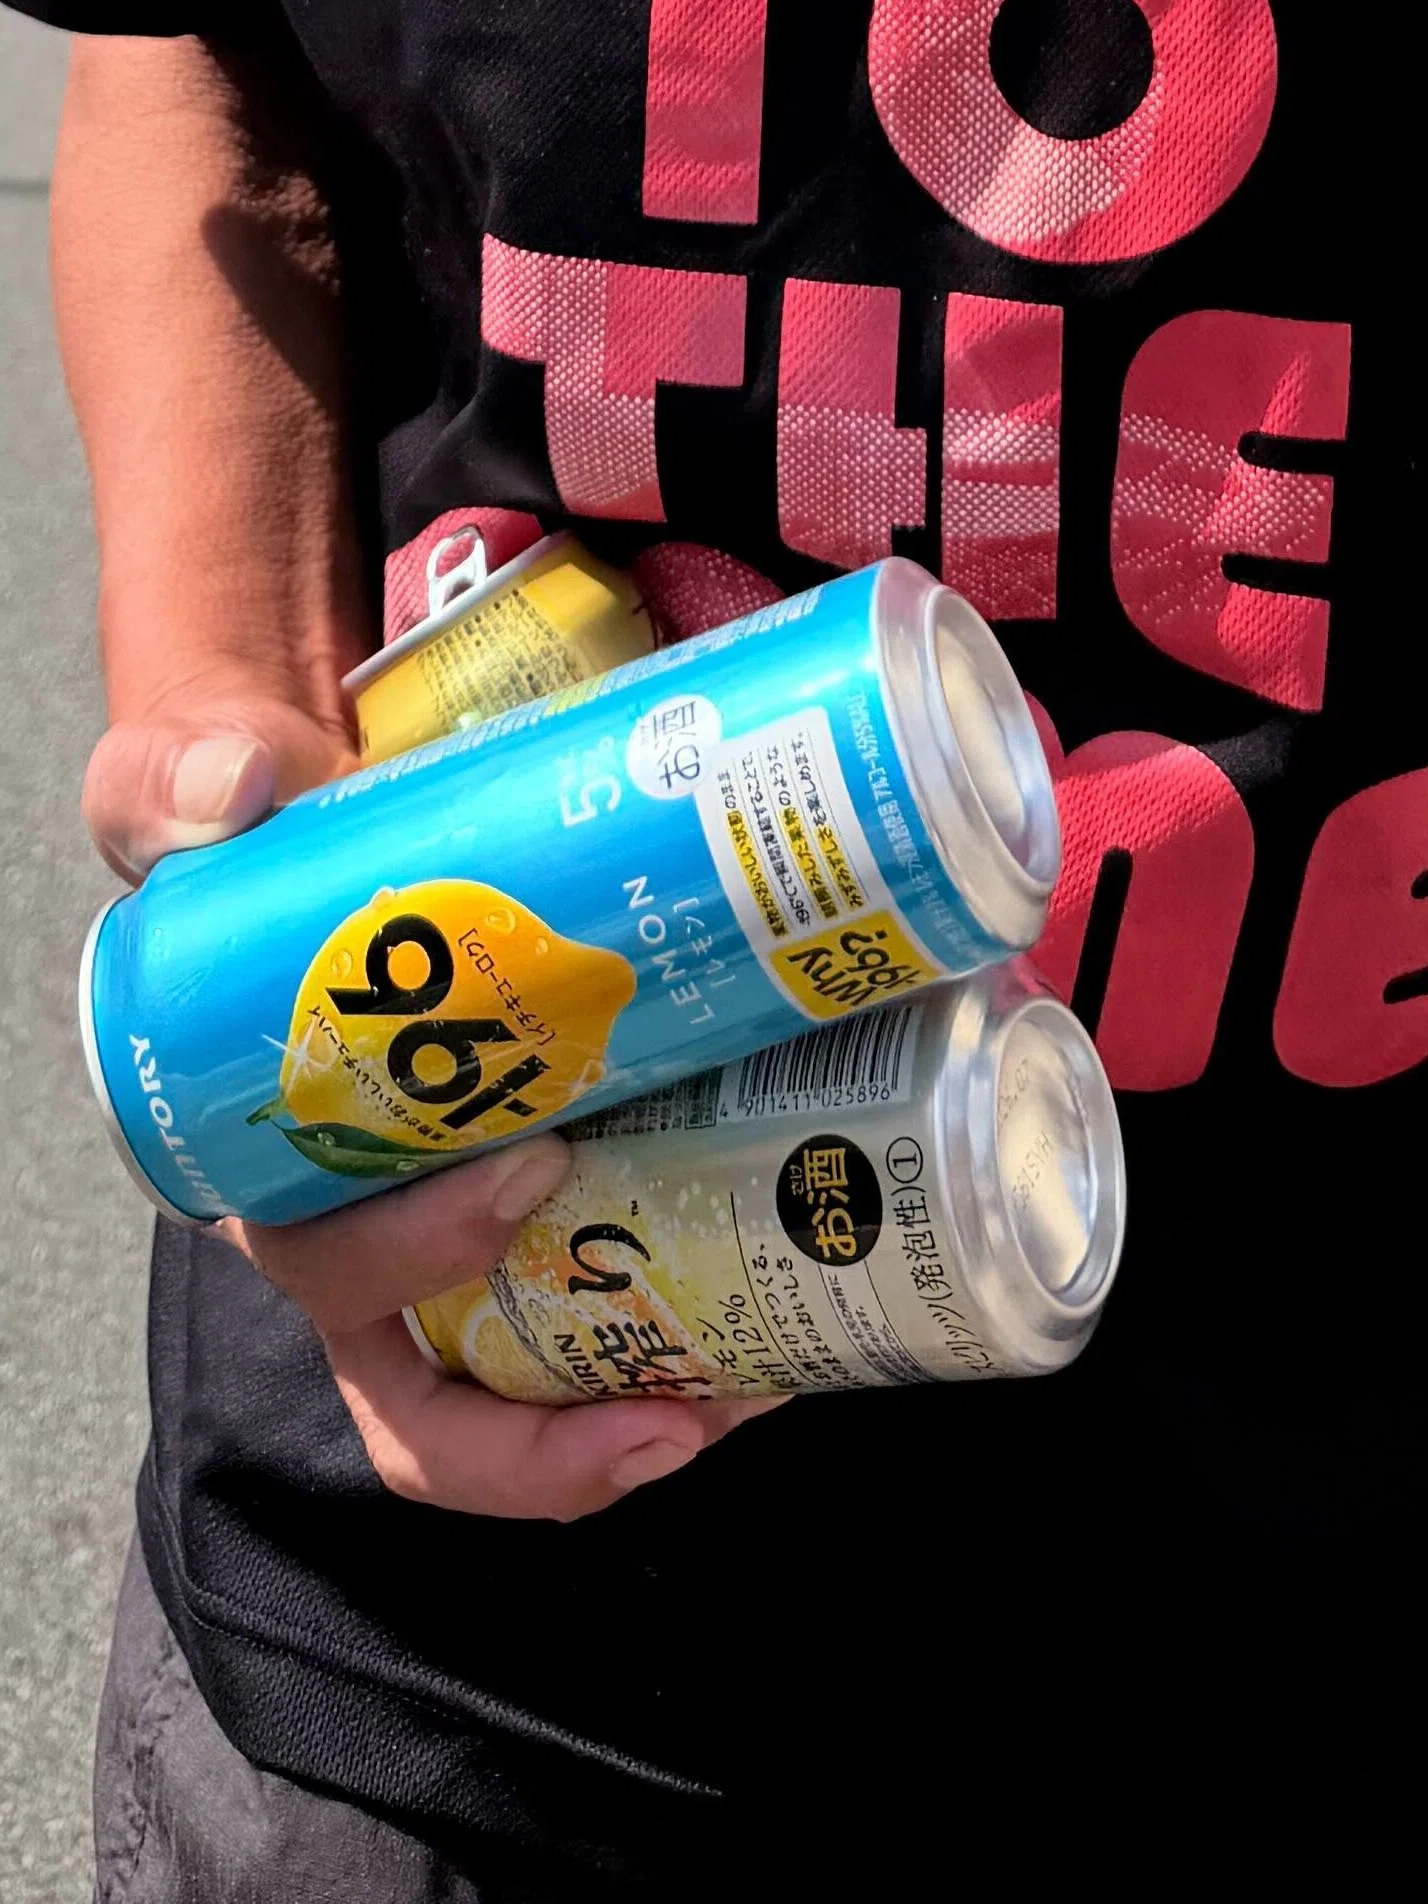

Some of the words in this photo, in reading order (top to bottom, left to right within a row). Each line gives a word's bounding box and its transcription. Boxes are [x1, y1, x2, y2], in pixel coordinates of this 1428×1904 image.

[479, 232, 1354, 712] THE
[654, 701, 701, 790] お酒
[623, 875, 715, 1024] LEMON
[787, 945, 878, 1007] Why
[325, 913, 551, 1131] -196
[820, 1084, 891, 1109] 025896
[804, 1148, 859, 1259] お酒
[568, 1222, 712, 1401] 搾り
[696, 1316, 760, 1387] レモン
[554, 1333, 618, 1398] KIRIN
